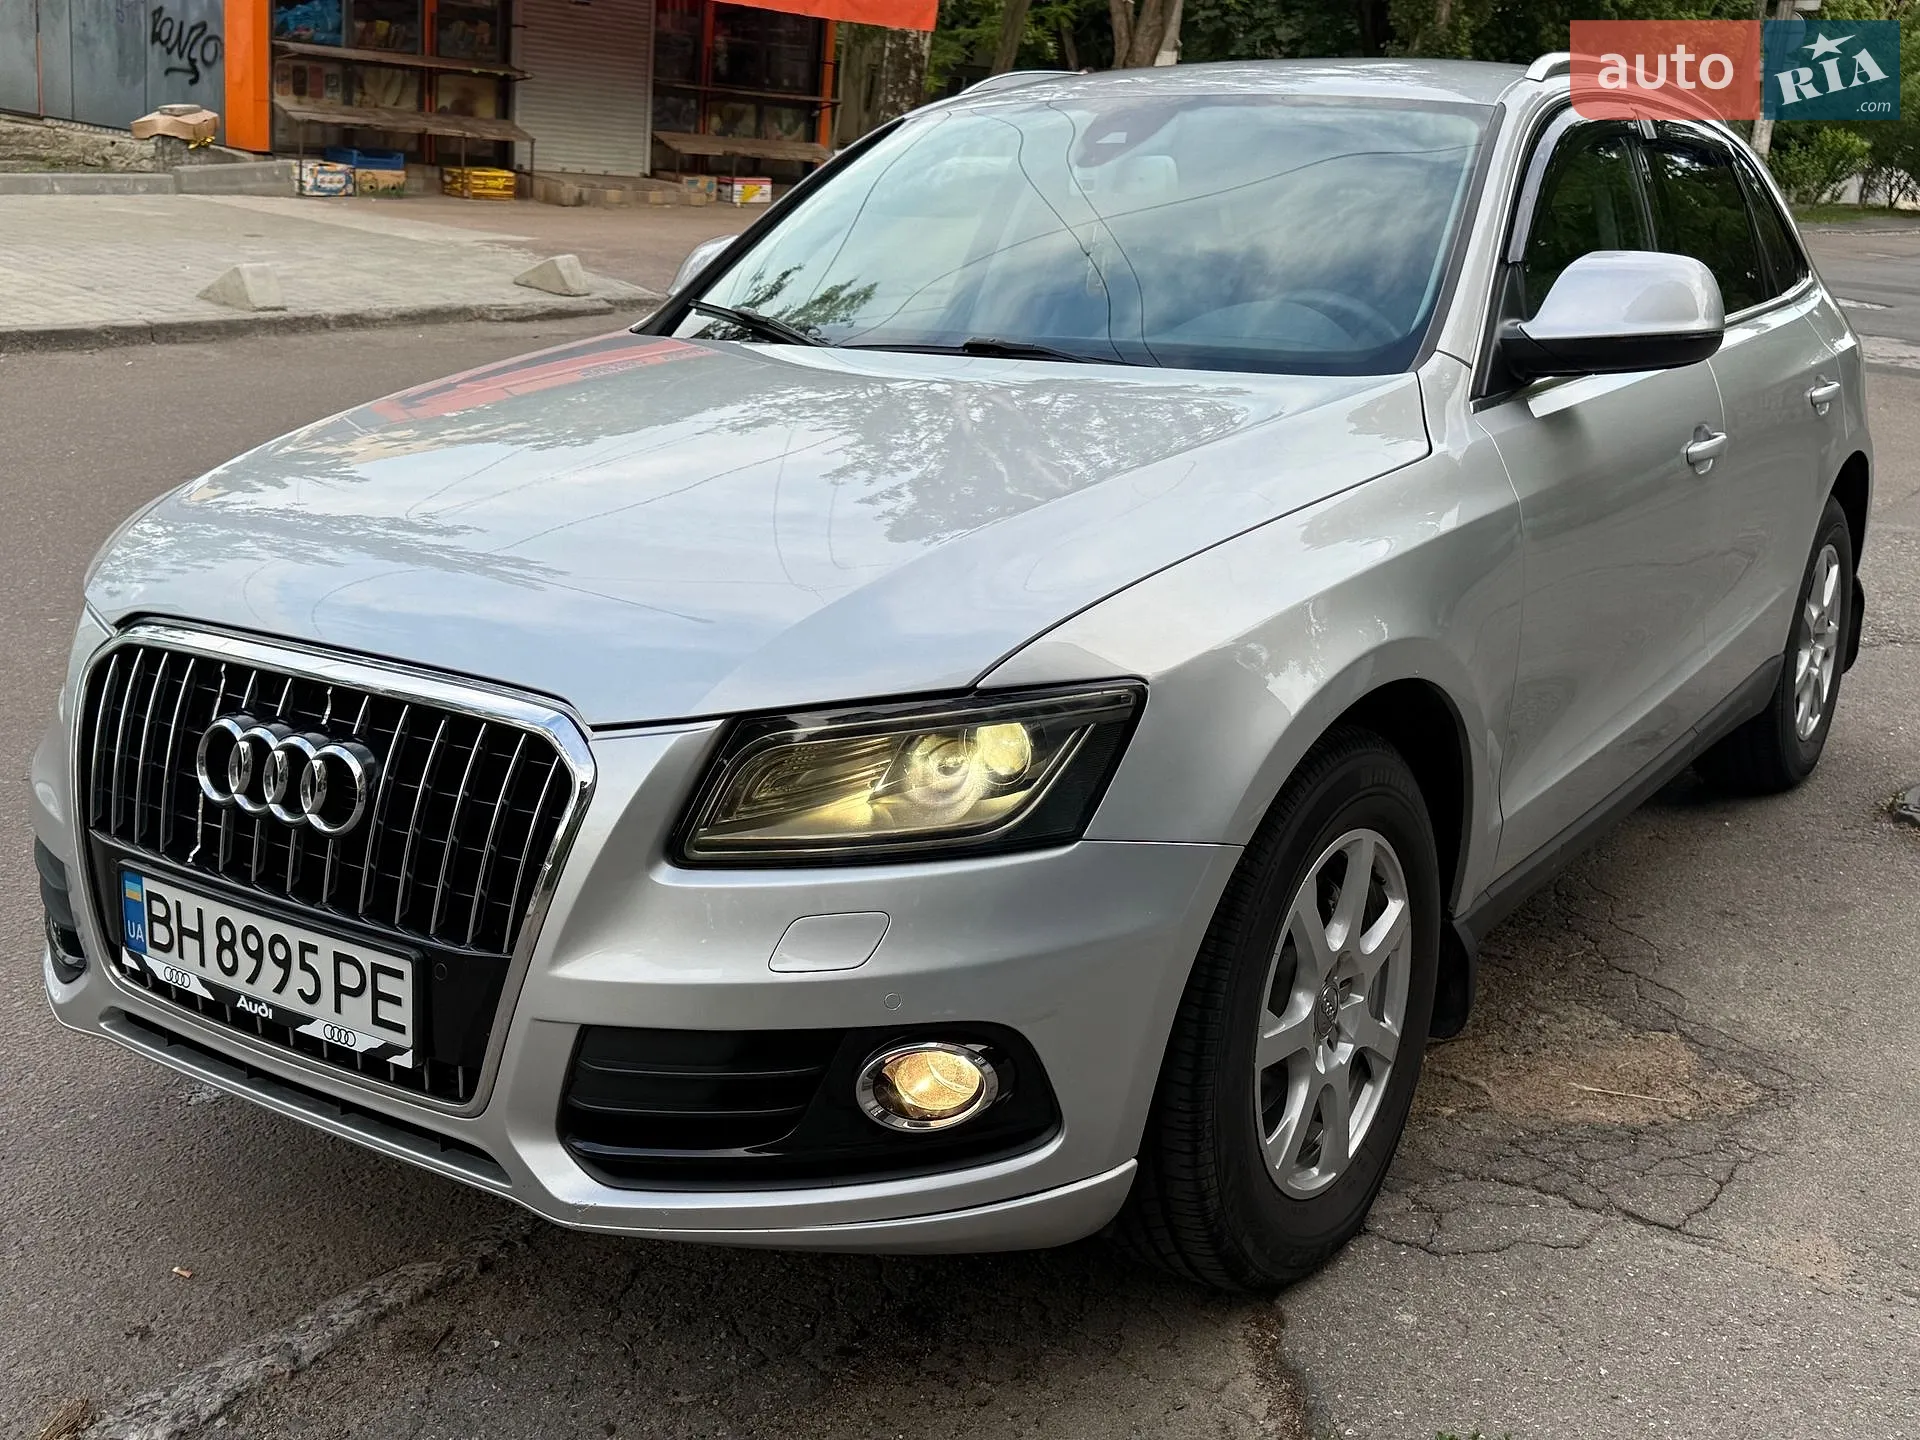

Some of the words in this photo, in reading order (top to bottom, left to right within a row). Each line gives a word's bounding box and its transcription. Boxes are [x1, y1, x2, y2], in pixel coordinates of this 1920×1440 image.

[127, 920, 144, 942] UA
[146, 889, 206, 967] BH
[215, 916, 321, 1004] 8995
[333, 951, 406, 1035] PE
[236, 995, 273, 1020] Audi
